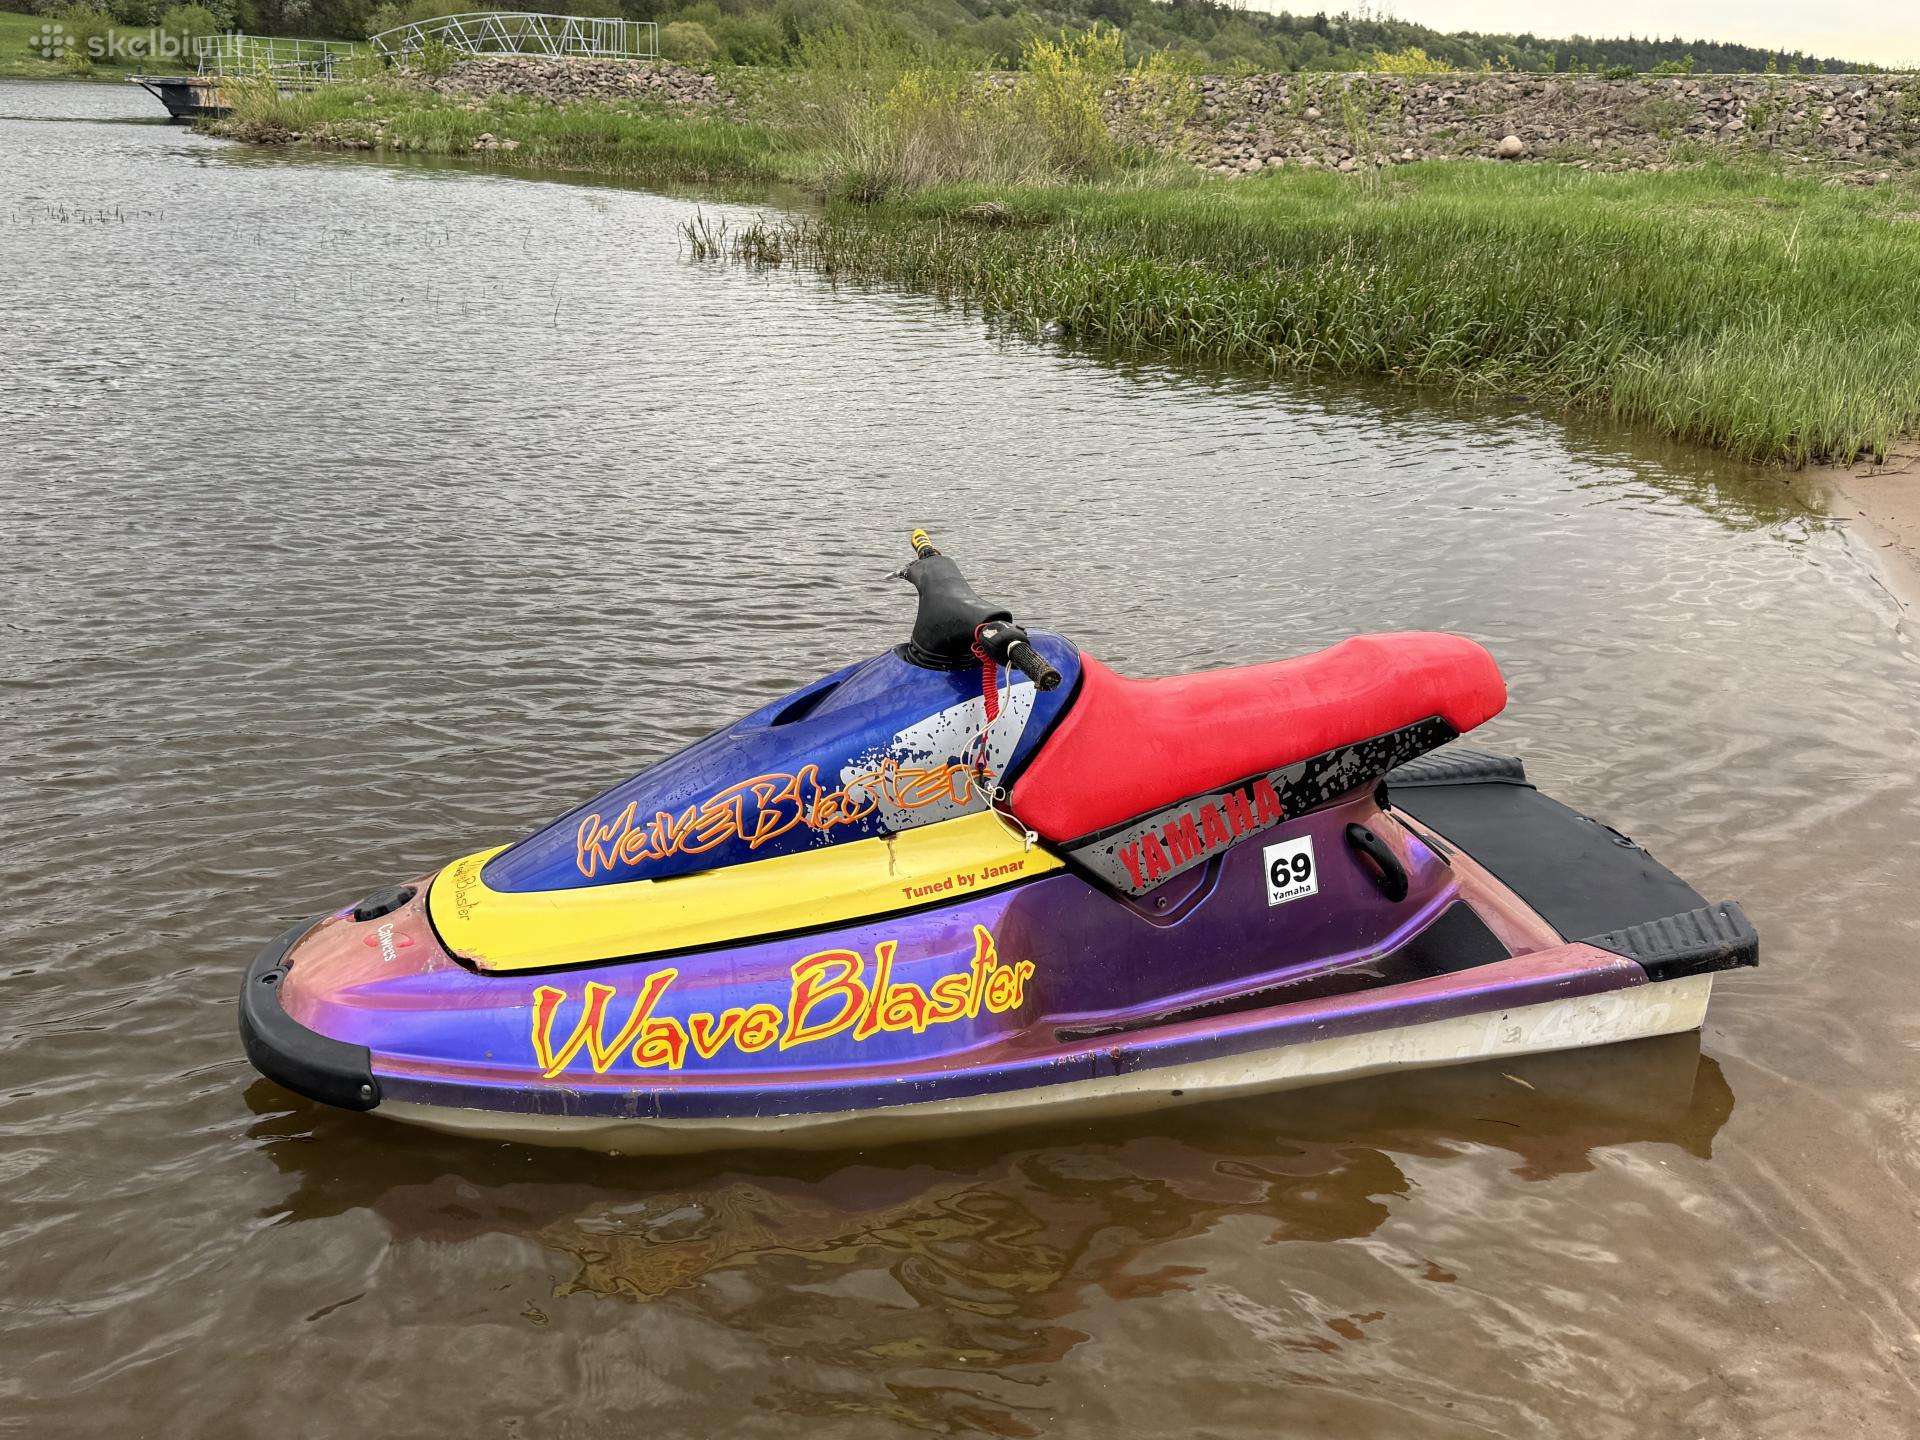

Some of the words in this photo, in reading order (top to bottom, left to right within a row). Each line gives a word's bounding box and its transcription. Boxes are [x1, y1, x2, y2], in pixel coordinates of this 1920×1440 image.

[1118, 777, 1284, 889] YAMAHA
[902, 877, 953, 900] Tuned
[956, 873, 976, 887] by
[980, 859, 1025, 881] Janar
[1270, 852, 1312, 888] 69
[1273, 884, 1311, 901] Yamaha
[531, 924, 1035, 1078] WaveBlaster
